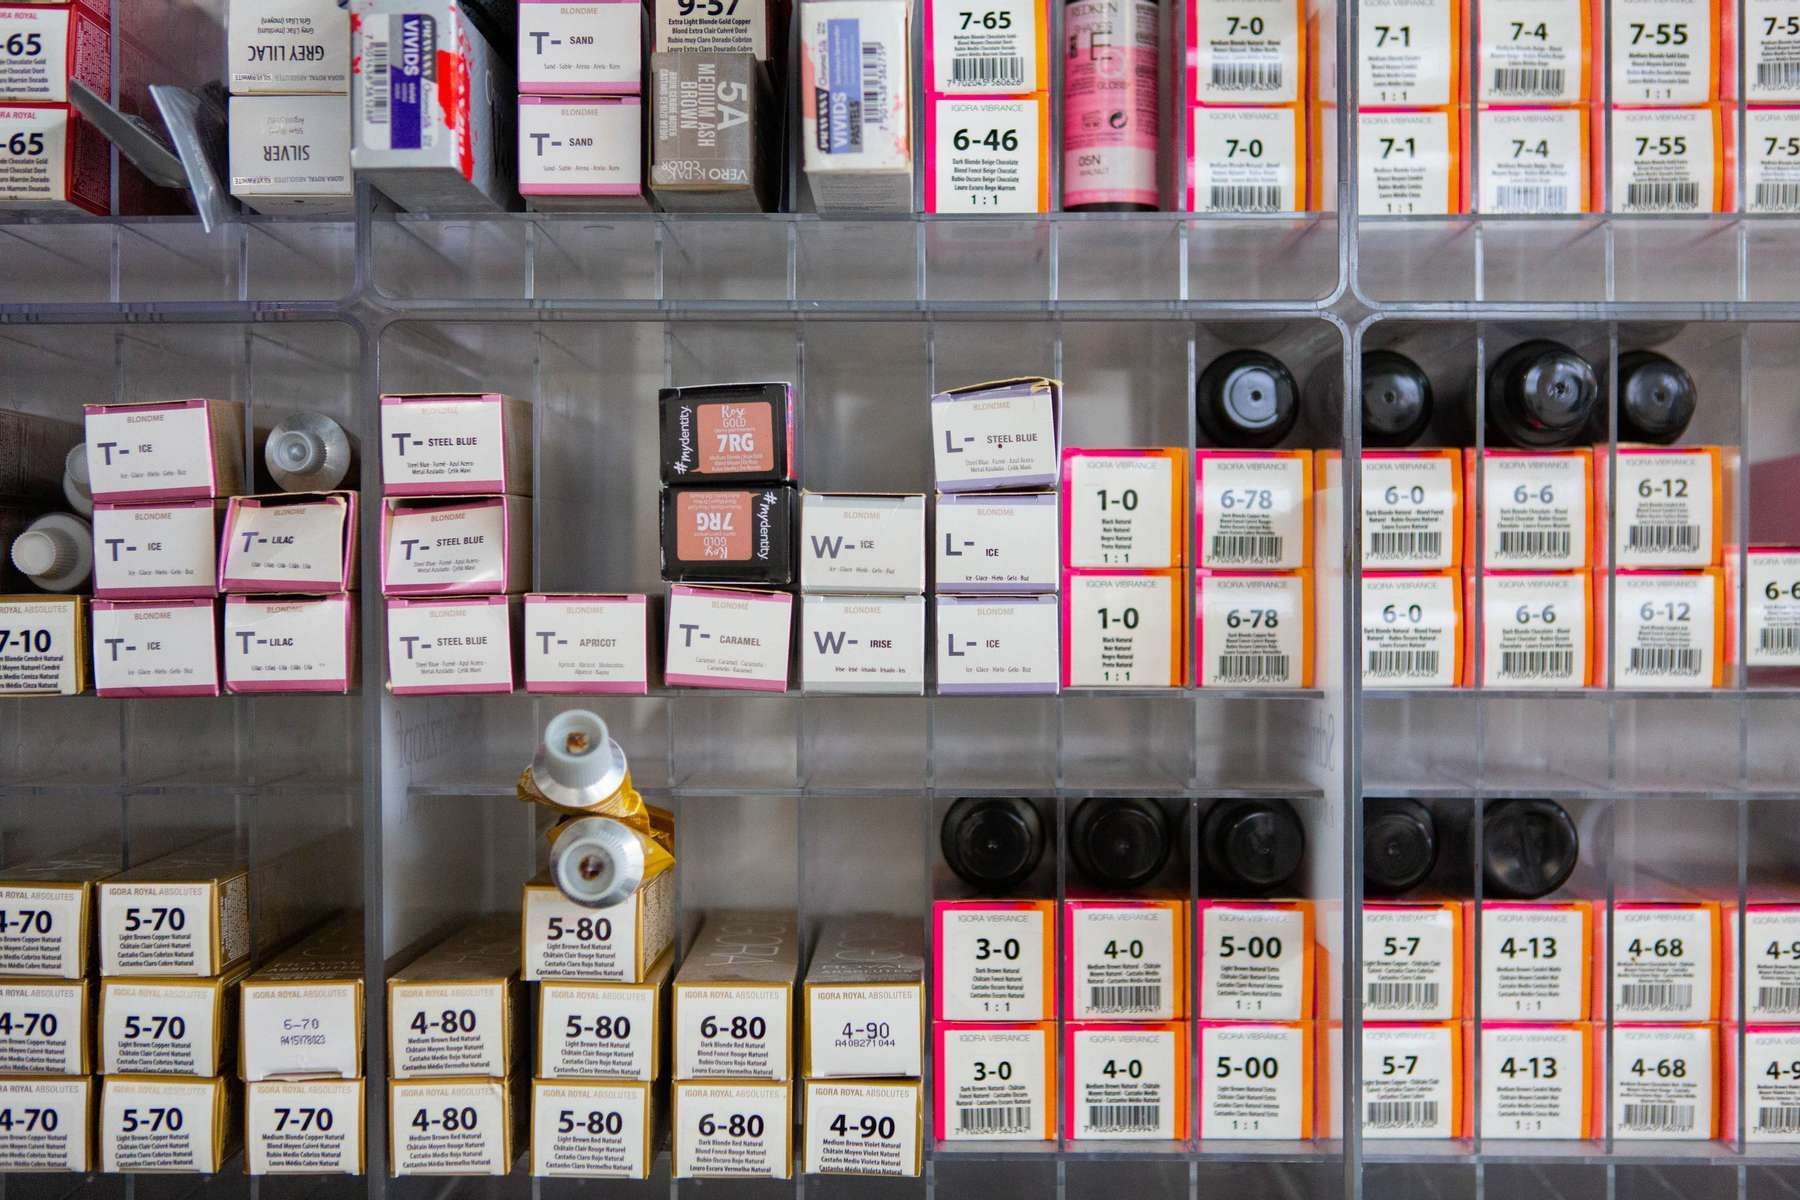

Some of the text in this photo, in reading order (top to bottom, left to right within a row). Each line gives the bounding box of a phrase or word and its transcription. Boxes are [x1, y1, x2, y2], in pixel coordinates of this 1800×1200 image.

[959, 12, 1012, 30] 7-65
[1226, 17, 1264, 36] 7-0
[1510, 22, 1548, 41] 7-4
[529, 32, 594, 55] T- SAND
[1374, 26, 1411, 47] 7-1
[1630, 23, 1688, 45] 7-55
[248, 45, 324, 61] GREY LILAC
[402, 19, 420, 77] VIVIDS
[680, 81, 698, 129] BROWN
[698, 64, 715, 147] MEDIUM ASH
[832, 92, 848, 149] VIVIDS
[850, 100, 861, 145] PASTELS
[529, 133, 594, 156] T- SAND
[952, 129, 1019, 152] 6-46
[1226, 139, 1263, 158] 7-0
[1379, 137, 1416, 159] 7-1
[1512, 140, 1549, 158] 7-4
[1635, 136, 1687, 156] 7-55
[263, 144, 311, 161] SILVER
[709, 168, 748, 180] VERO
[127, 414, 165, 423] BLONDME
[722, 417, 747, 428] GOLD
[392, 432, 478, 457] T- STEEL BLUE
[673, 405, 692, 476] #mydentity
[716, 433, 755, 453] 7RG
[945, 430, 1039, 454] L- STEEL BLUE
[97, 442, 153, 466] T- ICE
[1220, 489, 1273, 509] 6-78
[1384, 486, 1425, 505] 6-0
[1514, 485, 1555, 504] 6-6
[1638, 479, 1689, 498] 6-12
[1097, 489, 1139, 511] 1-0
[134, 512, 172, 521] BLONDME
[430, 513, 466, 522] BLONDME
[696, 512, 734, 532] 7RG
[976, 508, 1015, 517] BLONDME
[756, 491, 778, 561] #mydentity
[104, 538, 163, 562] T- ICE
[241, 531, 294, 553] T- LILAC
[400, 536, 485, 561] T- STEEL BLUE
[704, 536, 728, 547] GOLD
[810, 535, 875, 560] W- ICE
[946, 533, 1000, 557] L- ICE
[566, 606, 604, 615] BLONDME
[1097, 608, 1140, 630] 1-0
[1226, 609, 1279, 629] 6-78
[1382, 604, 1423, 624] 6-0
[1516, 605, 1557, 624] 6-6
[1640, 602, 1691, 622] 6-12
[0, 629, 51, 653] 7-10
[235, 631, 294, 655] T- LILAC
[536, 631, 617, 655] T- APRICOT
[679, 623, 762, 648] T- CARAMEL
[814, 631, 893, 655] W- IRISE
[948, 633, 1001, 657] L- ICE
[104, 638, 161, 662] T- ICE
[400, 636, 488, 660] T- STEEL BLUE
[109, 887, 202, 896] IGORA ROYAL ABSOLUTES
[124, 908, 186, 932] 5-70
[546, 917, 612, 941] 5-80
[118, 934, 133, 942] Light
[151, 934, 170, 942] Copper
[1219, 936, 1282, 959] 5-00
[1384, 937, 1421, 957] 5-7
[1500, 937, 1558, 959] 4-13
[1628, 938, 1684, 958] 4-68
[976, 938, 1021, 961] 3-0
[1104, 940, 1144, 960] 4-0
[124, 1016, 186, 1040] 5-70
[283, 1018, 320, 1030] 6-70
[411, 1010, 477, 1035] 4-80
[565, 1015, 631, 1040] 5-80
[700, 1015, 767, 1040] 6-80
[842, 1022, 890, 1040] 4-90
[974, 1060, 1013, 1082] 3-0
[1102, 1059, 1143, 1079] 4-0
[1216, 1056, 1279, 1079] 5-00
[1382, 1056, 1419, 1076] 5-7
[1500, 1056, 1558, 1079] 4-13
[1631, 1058, 1687, 1078] 4-68
[816, 1088, 910, 1098] IGORA ROYAL ABSOLUTES
[122, 1107, 183, 1132] 5-70
[274, 1108, 334, 1132] 7-70
[412, 1107, 478, 1132] 4-80
[557, 1110, 623, 1135] 5-80
[698, 1113, 765, 1138] 6-80
[830, 1114, 896, 1140] 4-90
